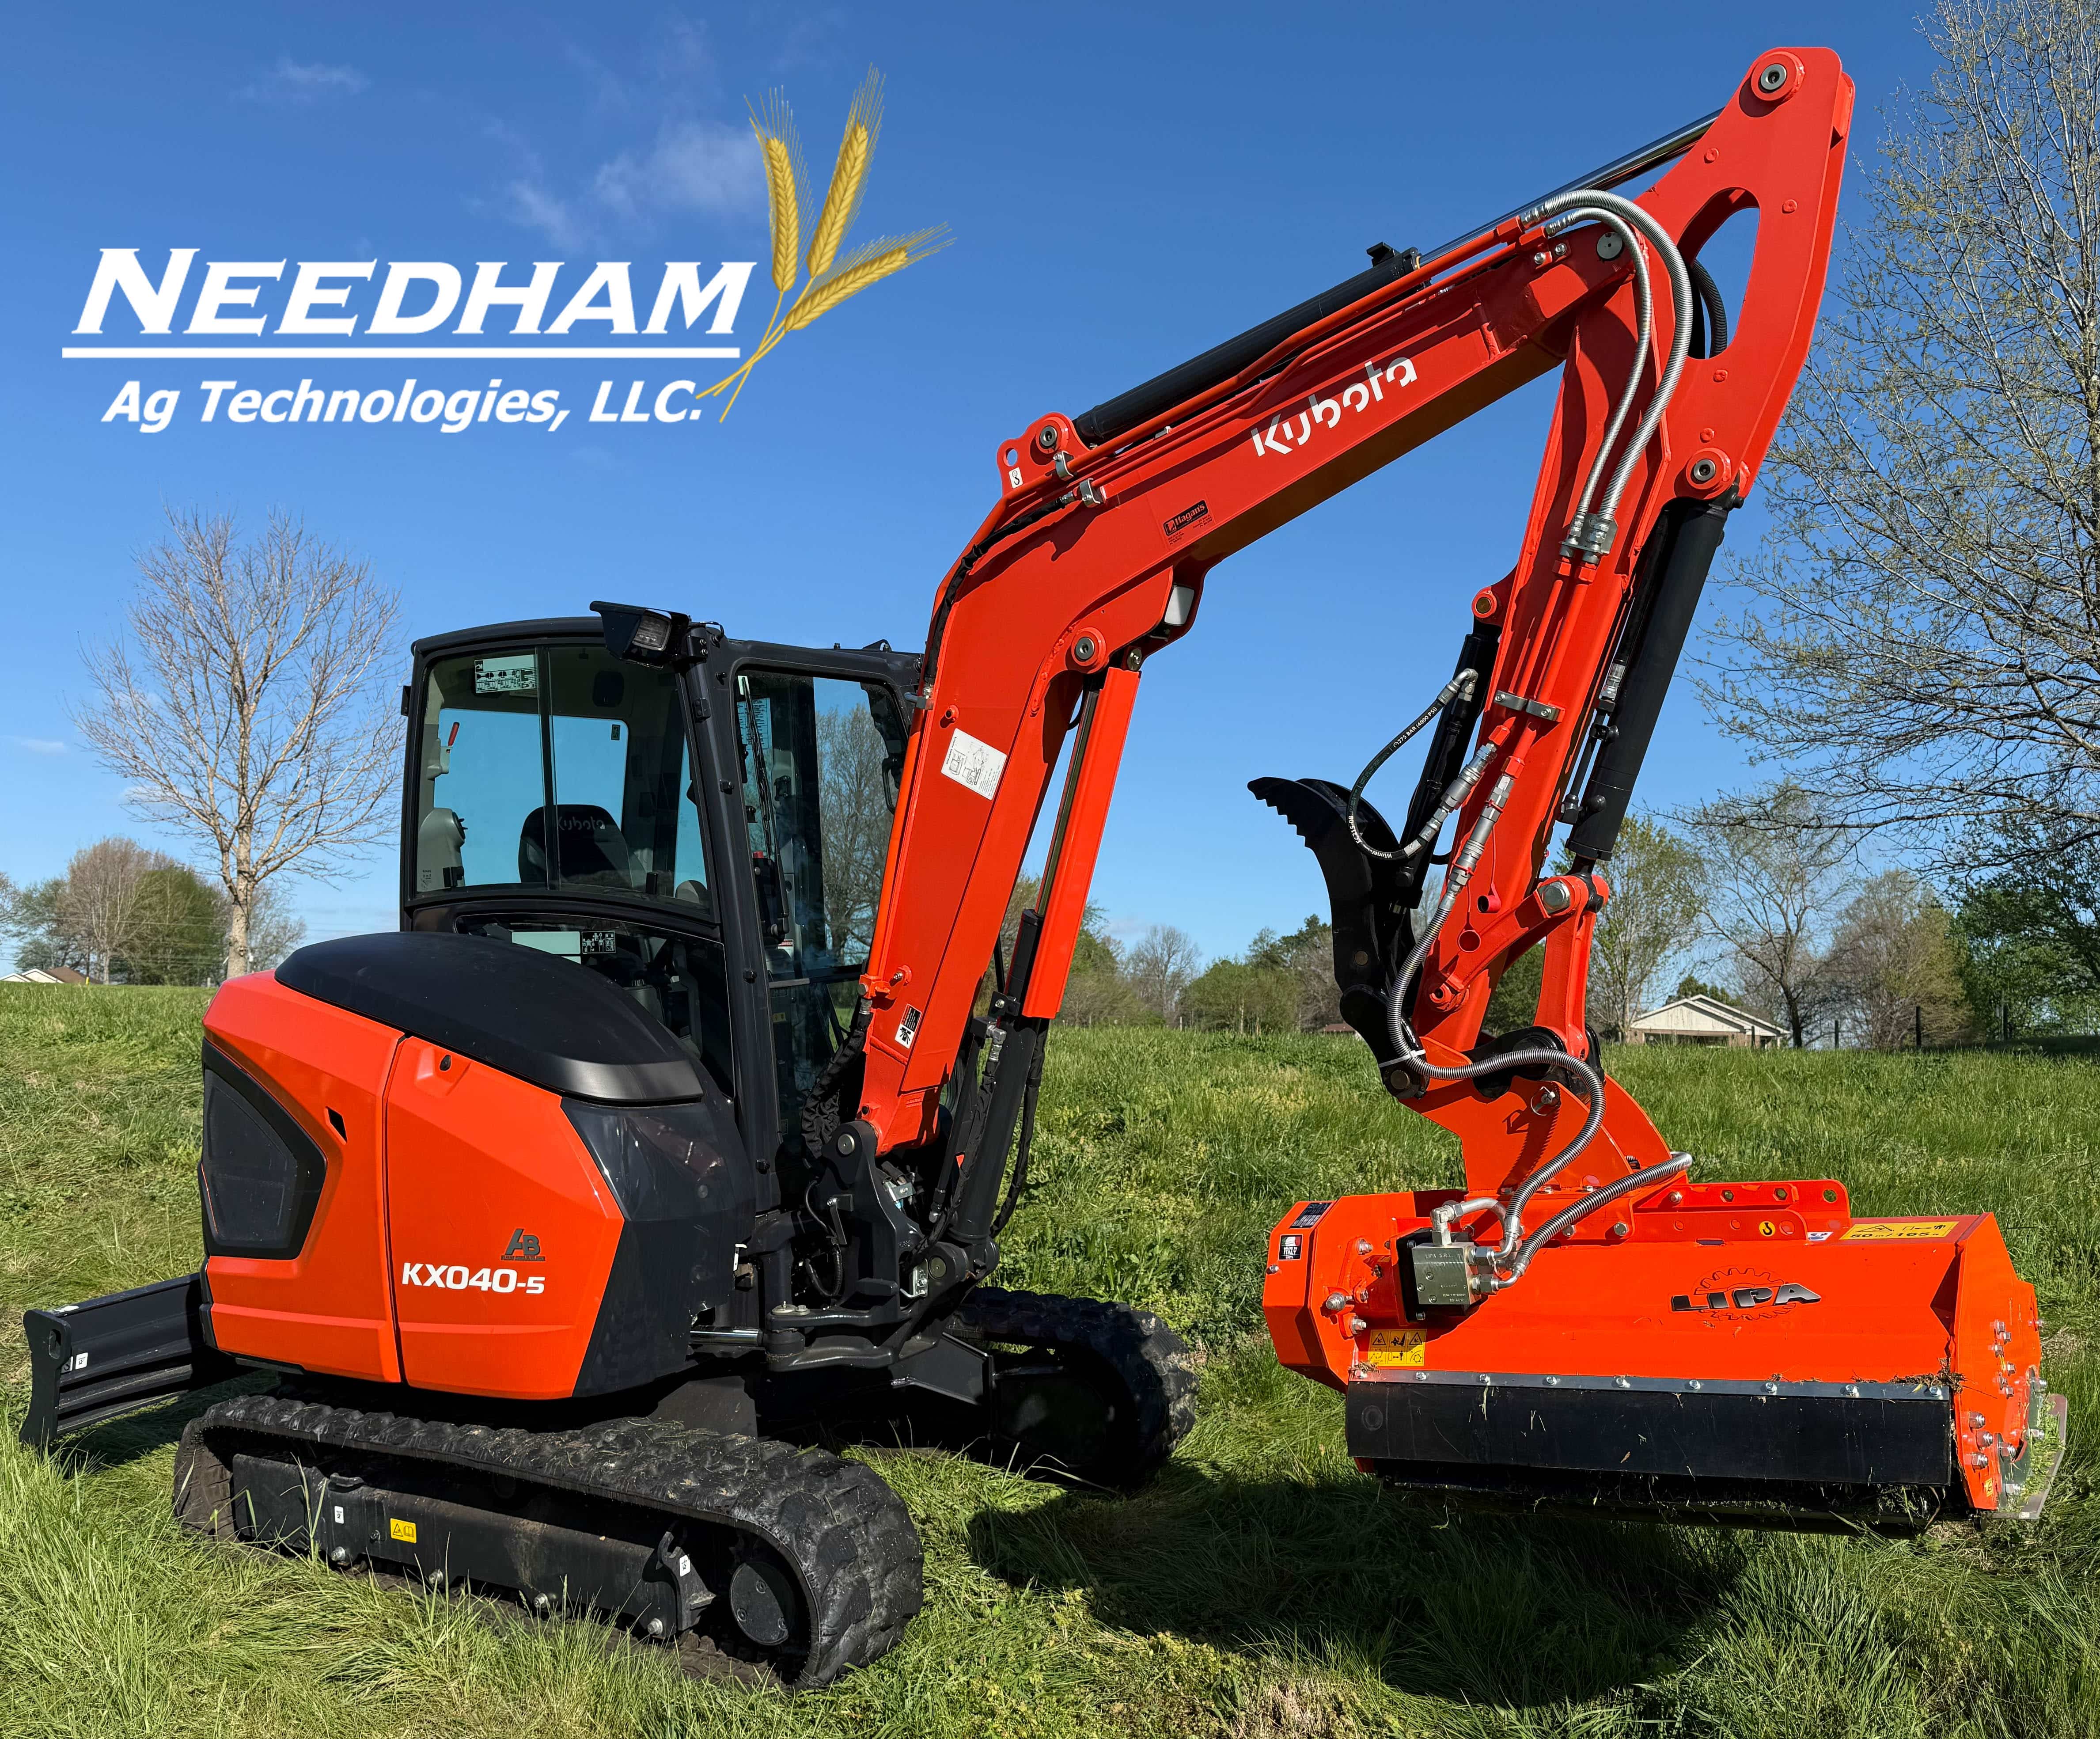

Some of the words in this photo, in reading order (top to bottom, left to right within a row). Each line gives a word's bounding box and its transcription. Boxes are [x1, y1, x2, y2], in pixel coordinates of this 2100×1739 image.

[1251, 357, 1418, 457] Kubota
[1406, 726, 1417, 736] BAR
[1416, 715, 1429, 728] (4000
[402, 1263, 545, 1294] KX040-5
[1672, 1283, 1821, 1311] LIPA
